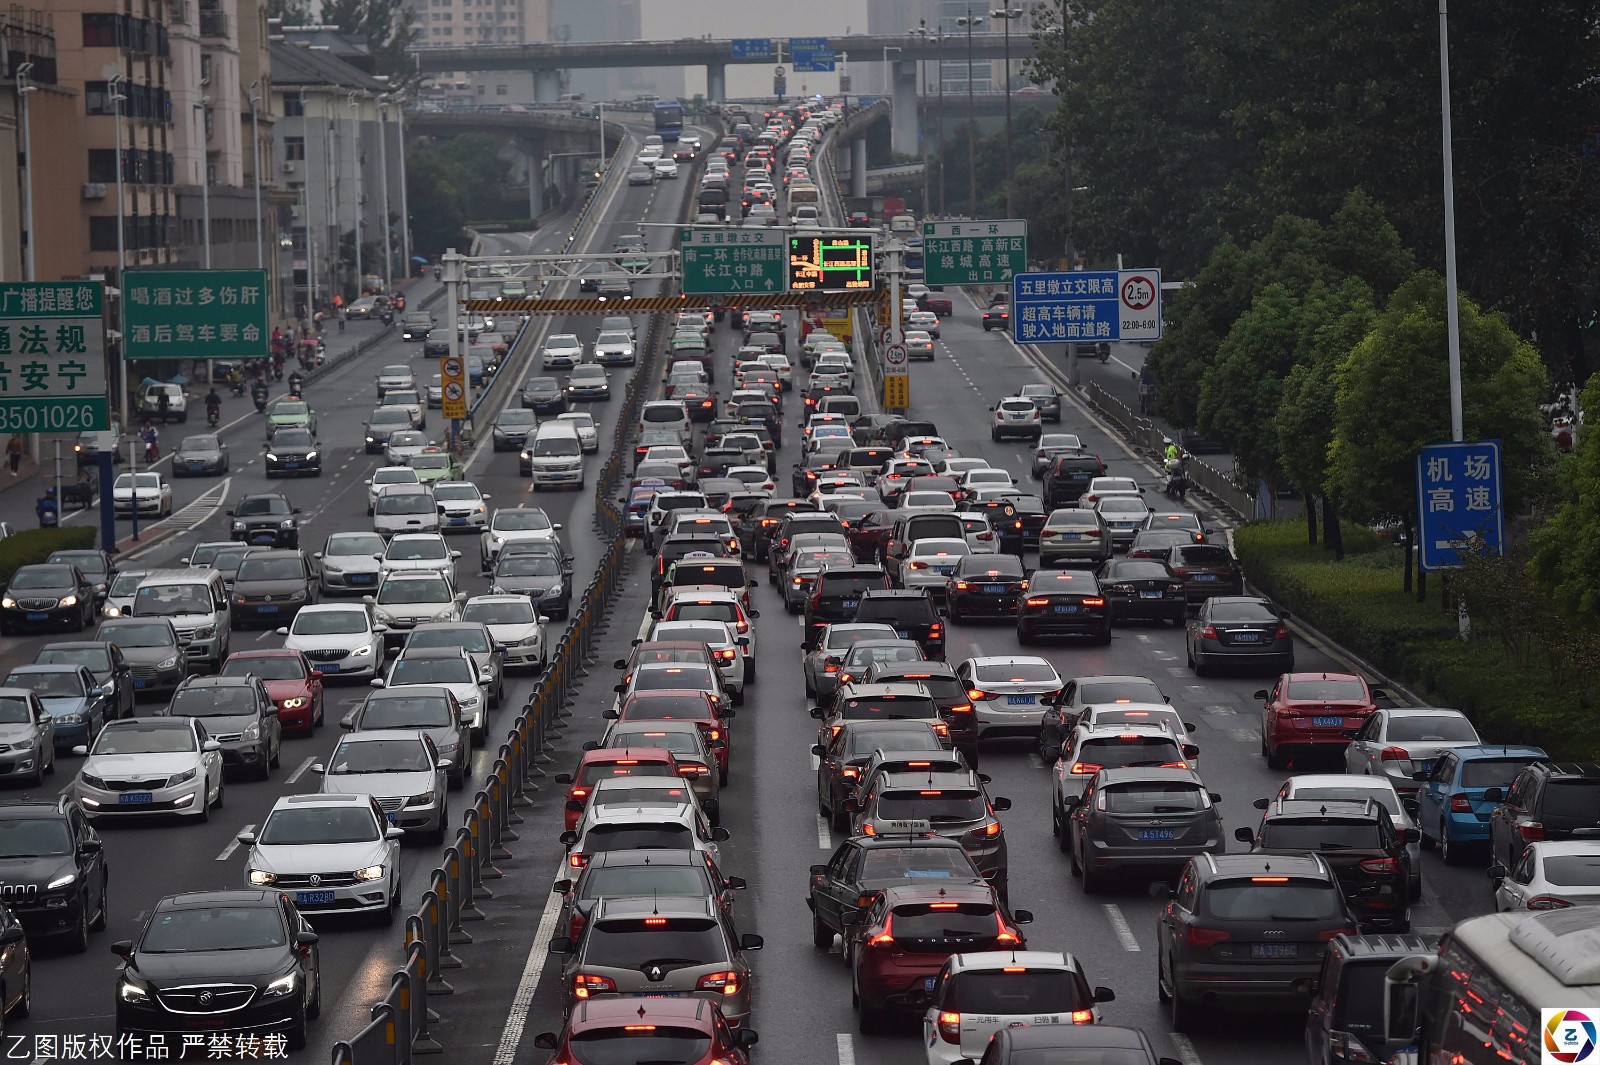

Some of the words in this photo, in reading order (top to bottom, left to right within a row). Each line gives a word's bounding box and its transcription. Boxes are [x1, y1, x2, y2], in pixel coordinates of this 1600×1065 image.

[701, 232, 764, 243] 五里墩立交
[951, 224, 999, 236] 西一环
[927, 239, 974, 253] 长江西路
[981, 238, 1023, 252] 高新区
[684, 248, 727, 262] 南一环
[941, 253, 1010, 269] 绕城高速
[703, 263, 764, 277] 长江中路
[968, 270, 993, 281] 出口
[731, 279, 753, 290] 入口
[1020, 278, 1114, 295] 五里墩立交限高
[3, 286, 94, 312] 广播提醒您
[130, 286, 260, 306] 喝酒过多伤肝
[1127, 285, 1149, 300] 2.5m
[1022, 304, 1096, 321] 超高车辆请
[1022, 321, 1111, 338] 驶入地面道路
[1122, 320, 1156, 330] 22:00-6:00
[131, 323, 260, 343] 酒后驾车要命
[1427, 455, 1491, 482] 机场
[1427, 485, 1492, 512] 高速
